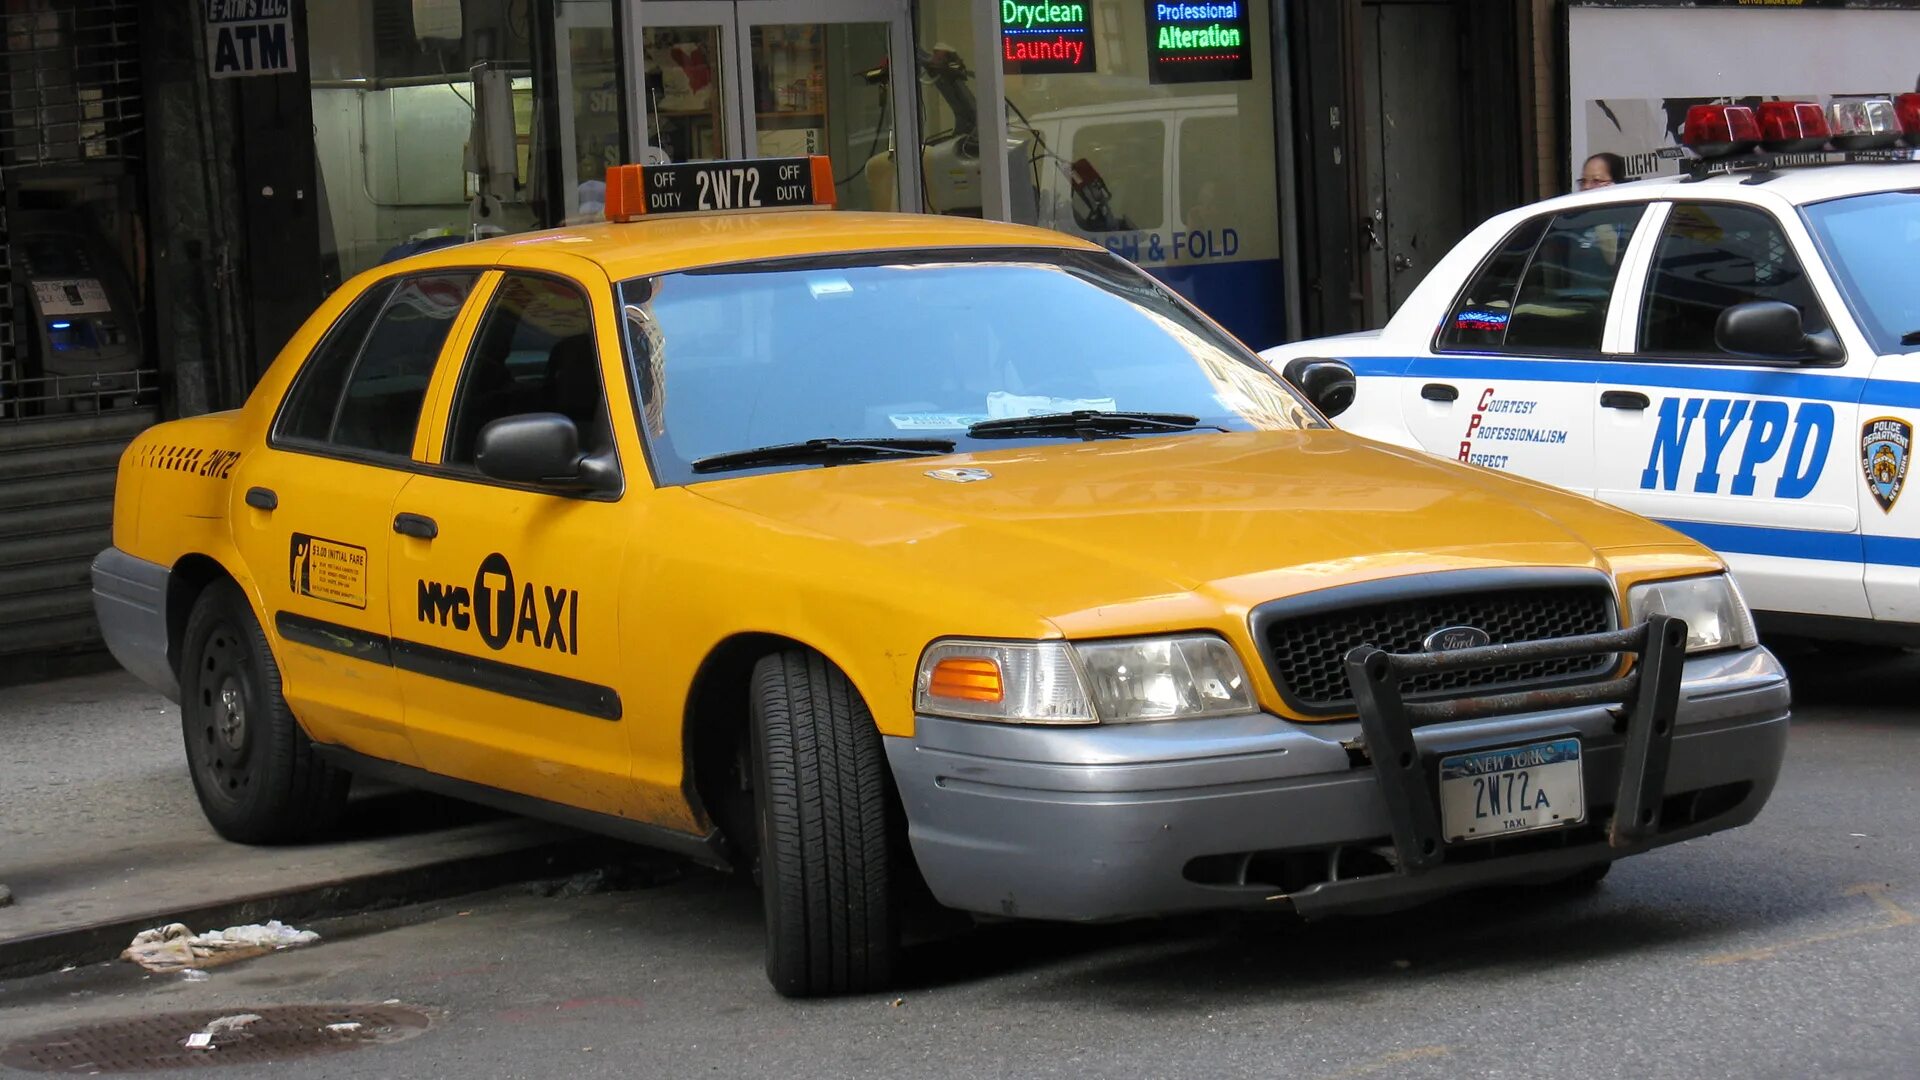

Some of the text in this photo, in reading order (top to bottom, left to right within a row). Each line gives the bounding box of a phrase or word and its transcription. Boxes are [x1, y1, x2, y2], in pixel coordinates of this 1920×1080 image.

[1003, 0, 1083, 28] Dryclean
[1157, 1, 1237, 21] Professional
[214, 24, 289, 72] ATM
[1158, 24, 1240, 48] Alteration
[1005, 36, 1084, 64] Laundry
[653, 172, 676, 188] OFF
[779, 165, 800, 180] OFF
[651, 193, 682, 208] DUTY
[695, 167, 762, 211] 2W72
[776, 185, 806, 201] DUTY
[1149, 233, 1165, 261] &
[1172, 228, 1239, 260] FOLD
[1873, 421, 1902, 433] POLICE
[1640, 397, 1835, 499] NYPD
[1863, 431, 1908, 449] DEPARTMENT
[200, 449, 241, 479] 2W72
[1863, 459, 1880, 496] CITY OF
[1888, 454, 1908, 501] NEW YORK
[349, 553, 364, 566] FARE
[418, 579, 470, 631] NYC
[1442, 633, 1475, 649] Ford
[1474, 749, 1545, 773] NEW YORK
[1503, 818, 1527, 829] TAXI
